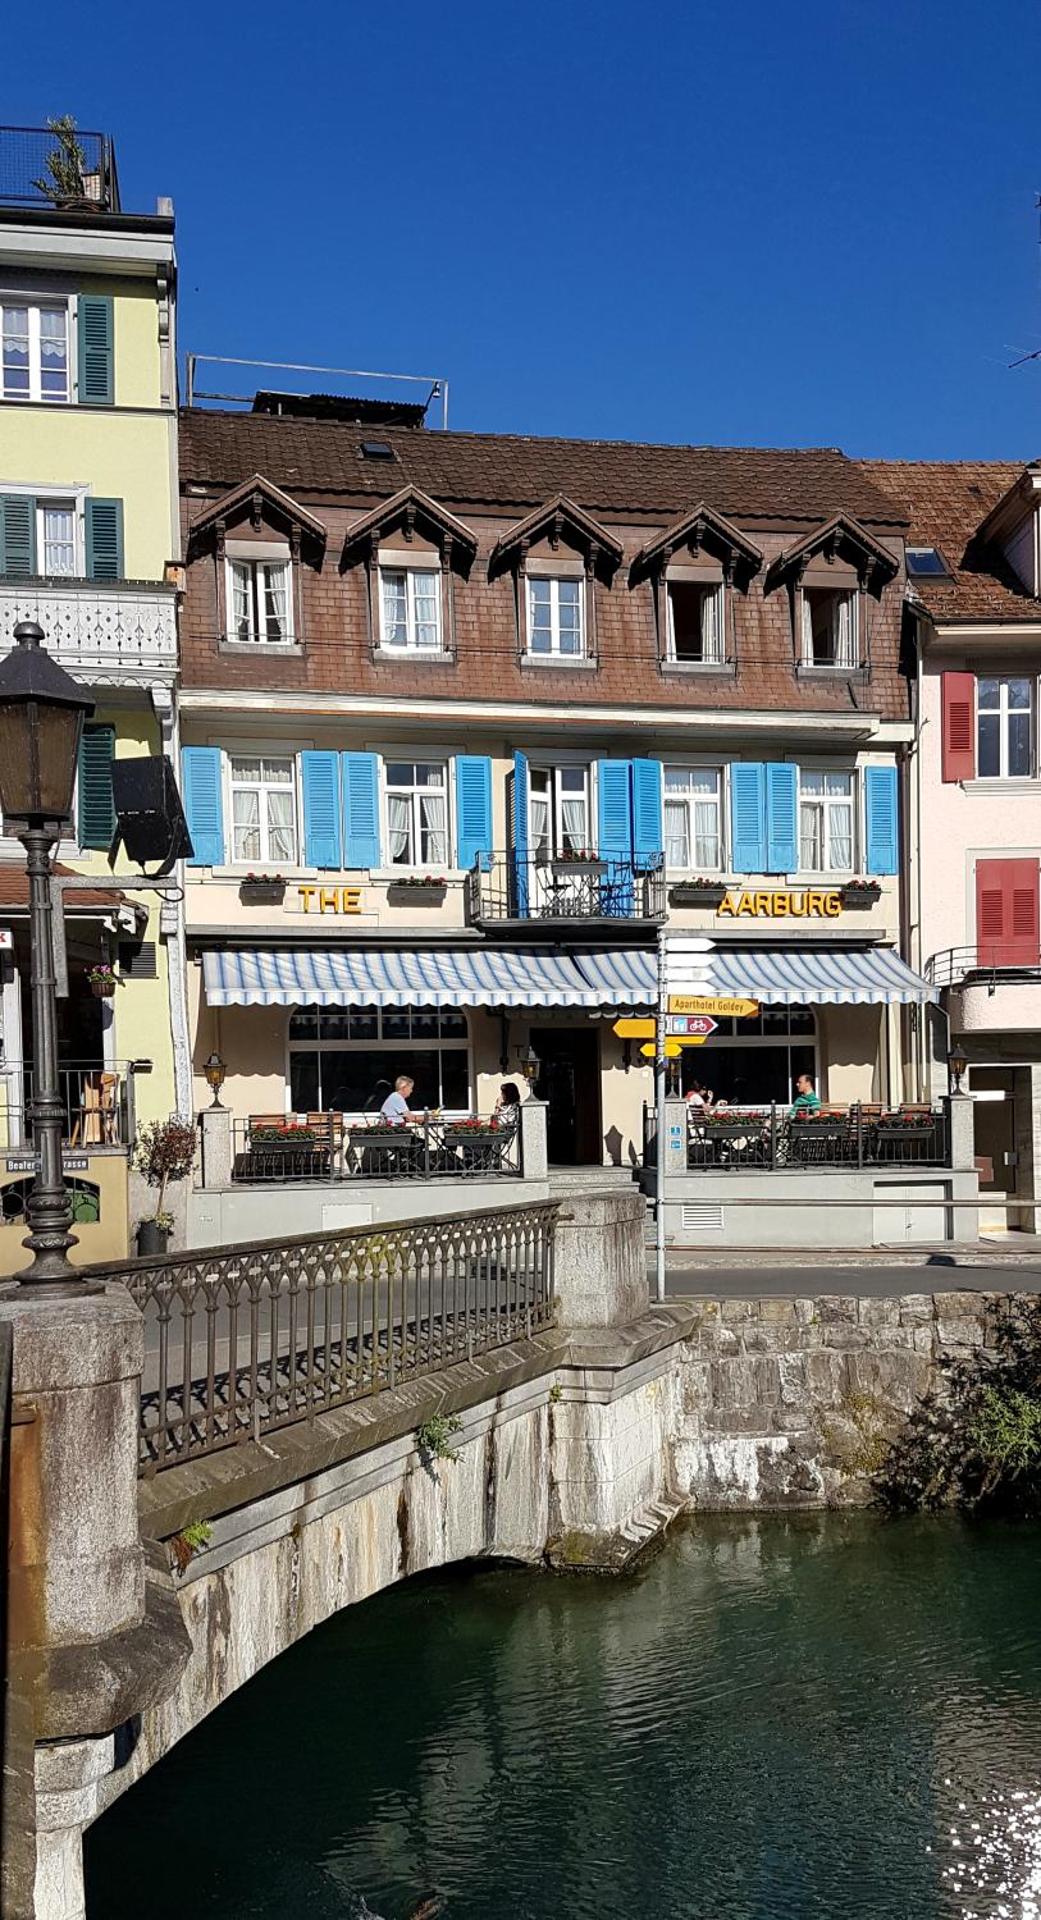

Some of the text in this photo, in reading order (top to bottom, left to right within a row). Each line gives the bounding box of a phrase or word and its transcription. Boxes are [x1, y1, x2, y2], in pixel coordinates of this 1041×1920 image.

[298, 885, 842, 918] THE AARBURG
[675, 999, 715, 1010] Aparthotel
